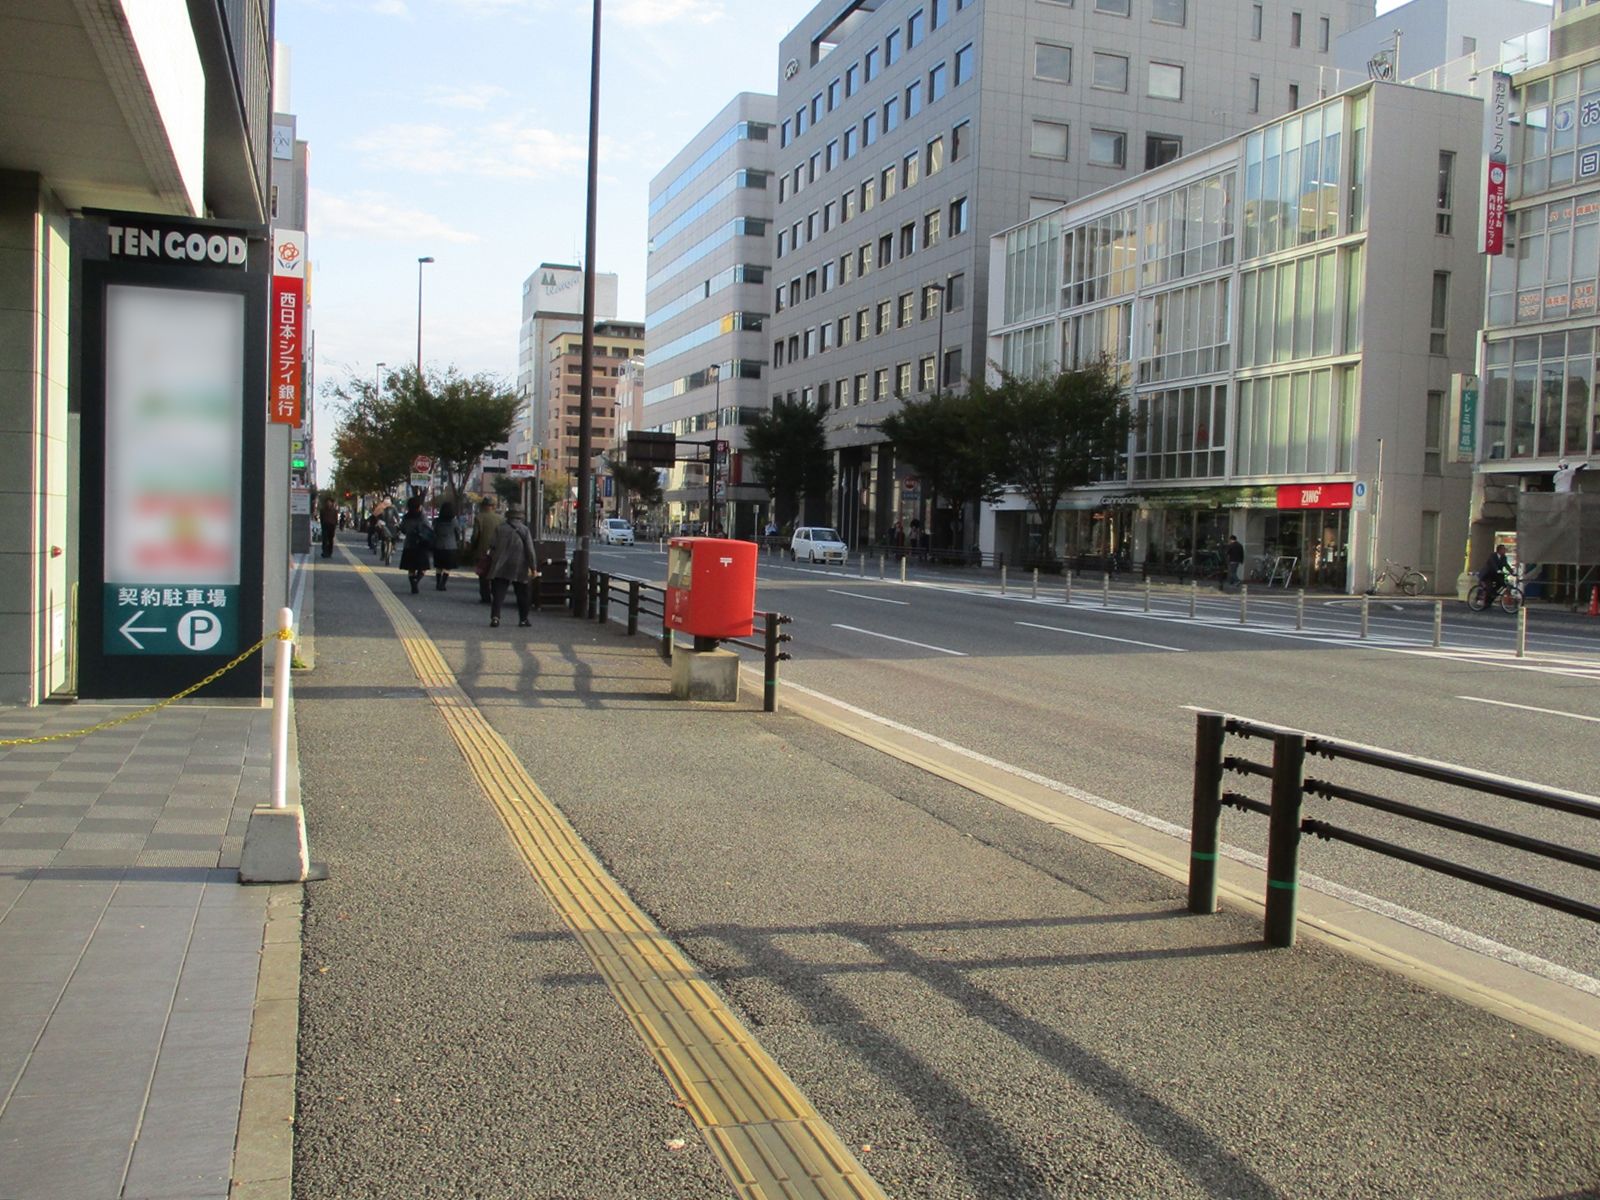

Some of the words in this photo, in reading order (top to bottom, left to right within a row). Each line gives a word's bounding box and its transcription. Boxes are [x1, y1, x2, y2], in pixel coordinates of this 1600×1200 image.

[107, 226, 161, 257] TEN
[164, 231, 247, 265] GOOD
[278, 292, 297, 417] 西日本シティ銀行
[118, 587, 228, 608] 契約駐車場
[189, 615, 214, 647] P
